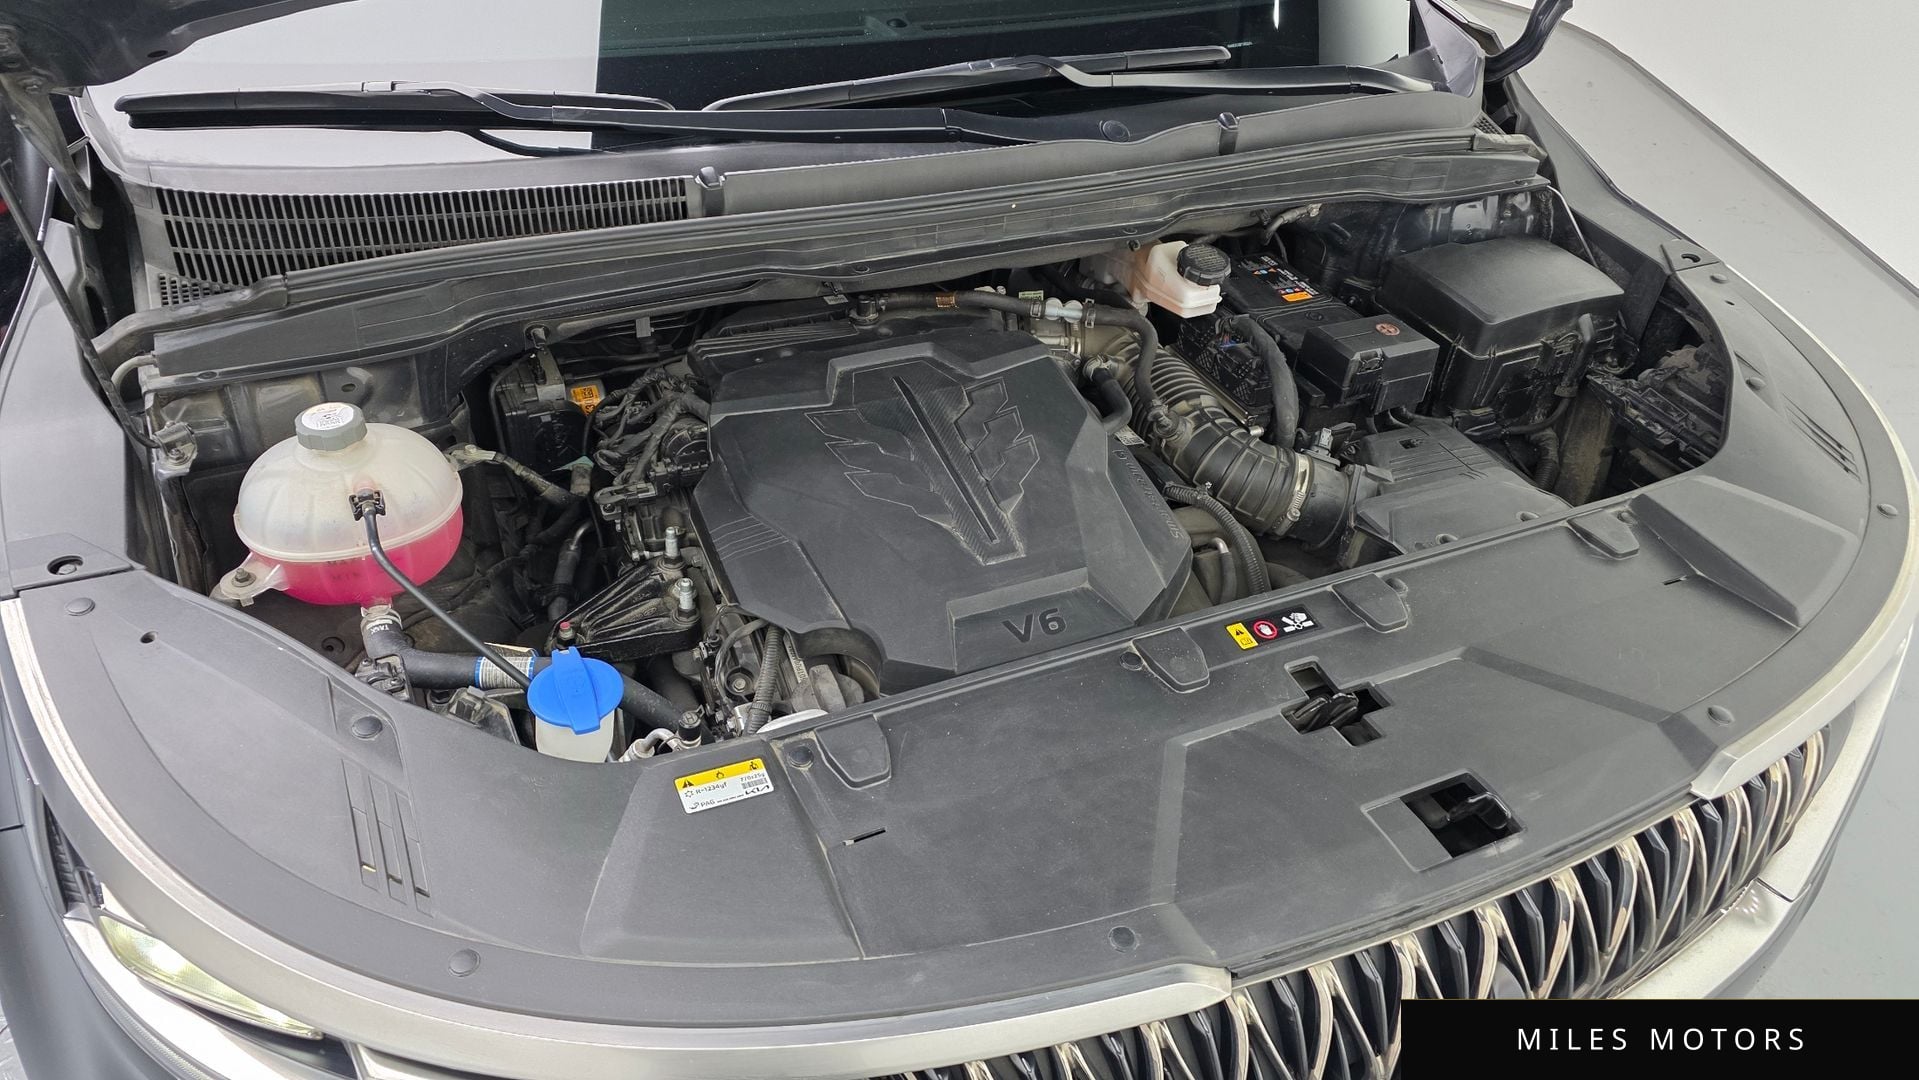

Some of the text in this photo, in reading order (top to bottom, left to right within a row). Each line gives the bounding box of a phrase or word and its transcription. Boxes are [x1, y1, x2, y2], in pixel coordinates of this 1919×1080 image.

[1001, 607, 1067, 643] V6
[695, 781, 727, 795] R-1234yf
[745, 785, 770, 795] KIA
[700, 799, 716, 808] PAG
